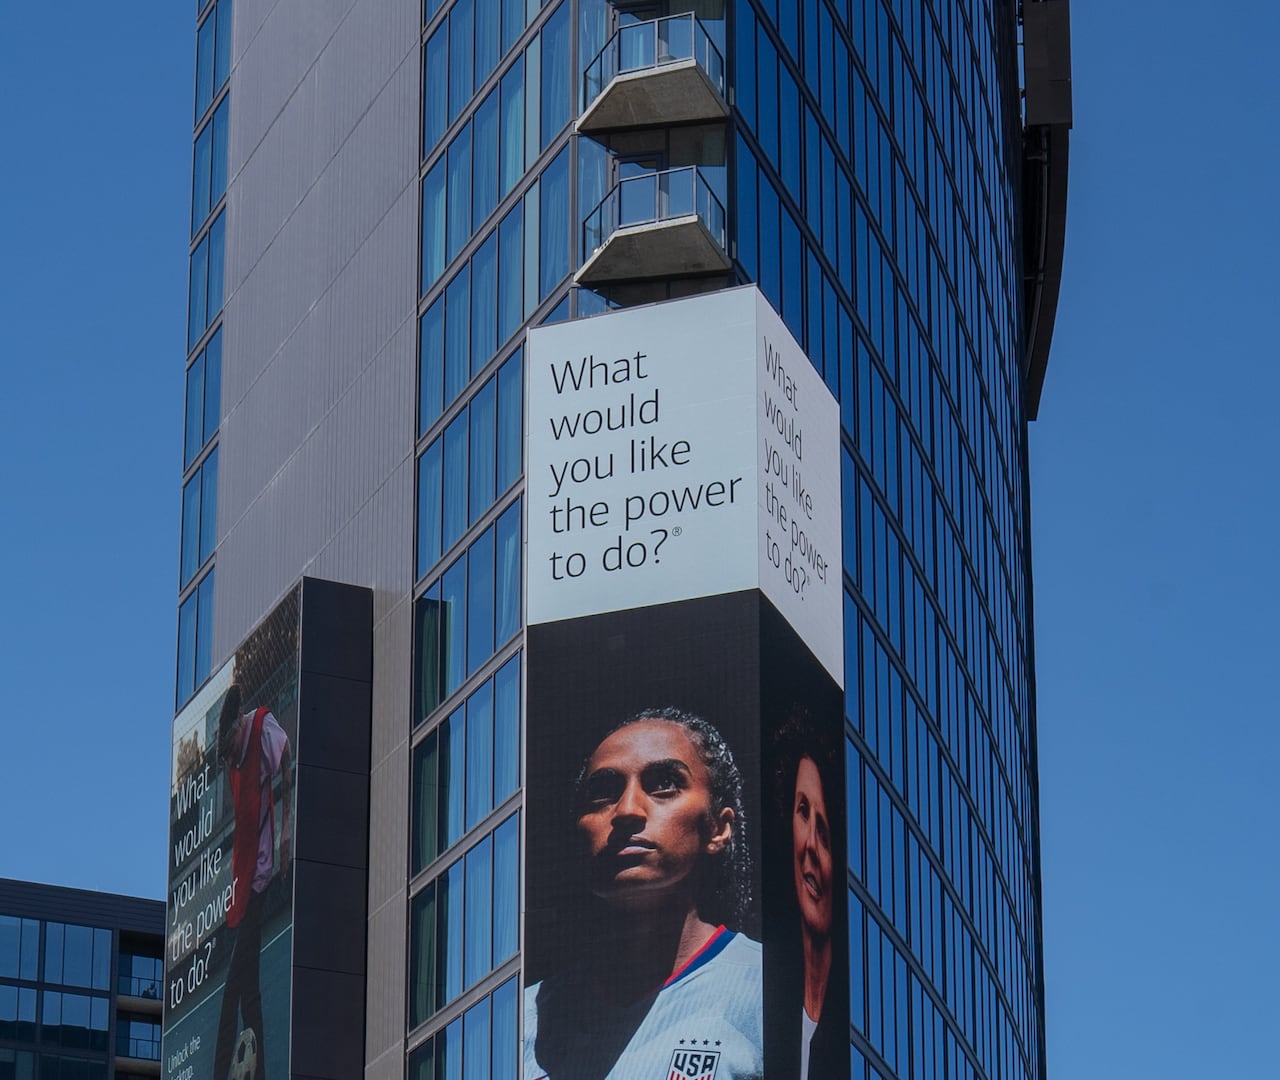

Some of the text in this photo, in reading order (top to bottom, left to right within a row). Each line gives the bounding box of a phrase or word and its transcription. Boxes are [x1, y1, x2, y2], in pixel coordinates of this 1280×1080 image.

[550, 351, 648, 394] What
[763, 335, 798, 412] What
[549, 388, 659, 441] would
[764, 391, 802, 461] would
[548, 436, 691, 497] you like
[764, 437, 812, 520] you like
[549, 477, 742, 533] the power
[765, 482, 828, 585] the power
[549, 551, 586, 580] to
[766, 529, 780, 569] to
[174, 763, 210, 820] What
[174, 798, 213, 868] would
[172, 847, 222, 927] you like
[171, 876, 238, 963] the power
[170, 975, 184, 1009] to
[167, 1036, 200, 1074] Unlock the
[674, 1052, 716, 1077] USA
